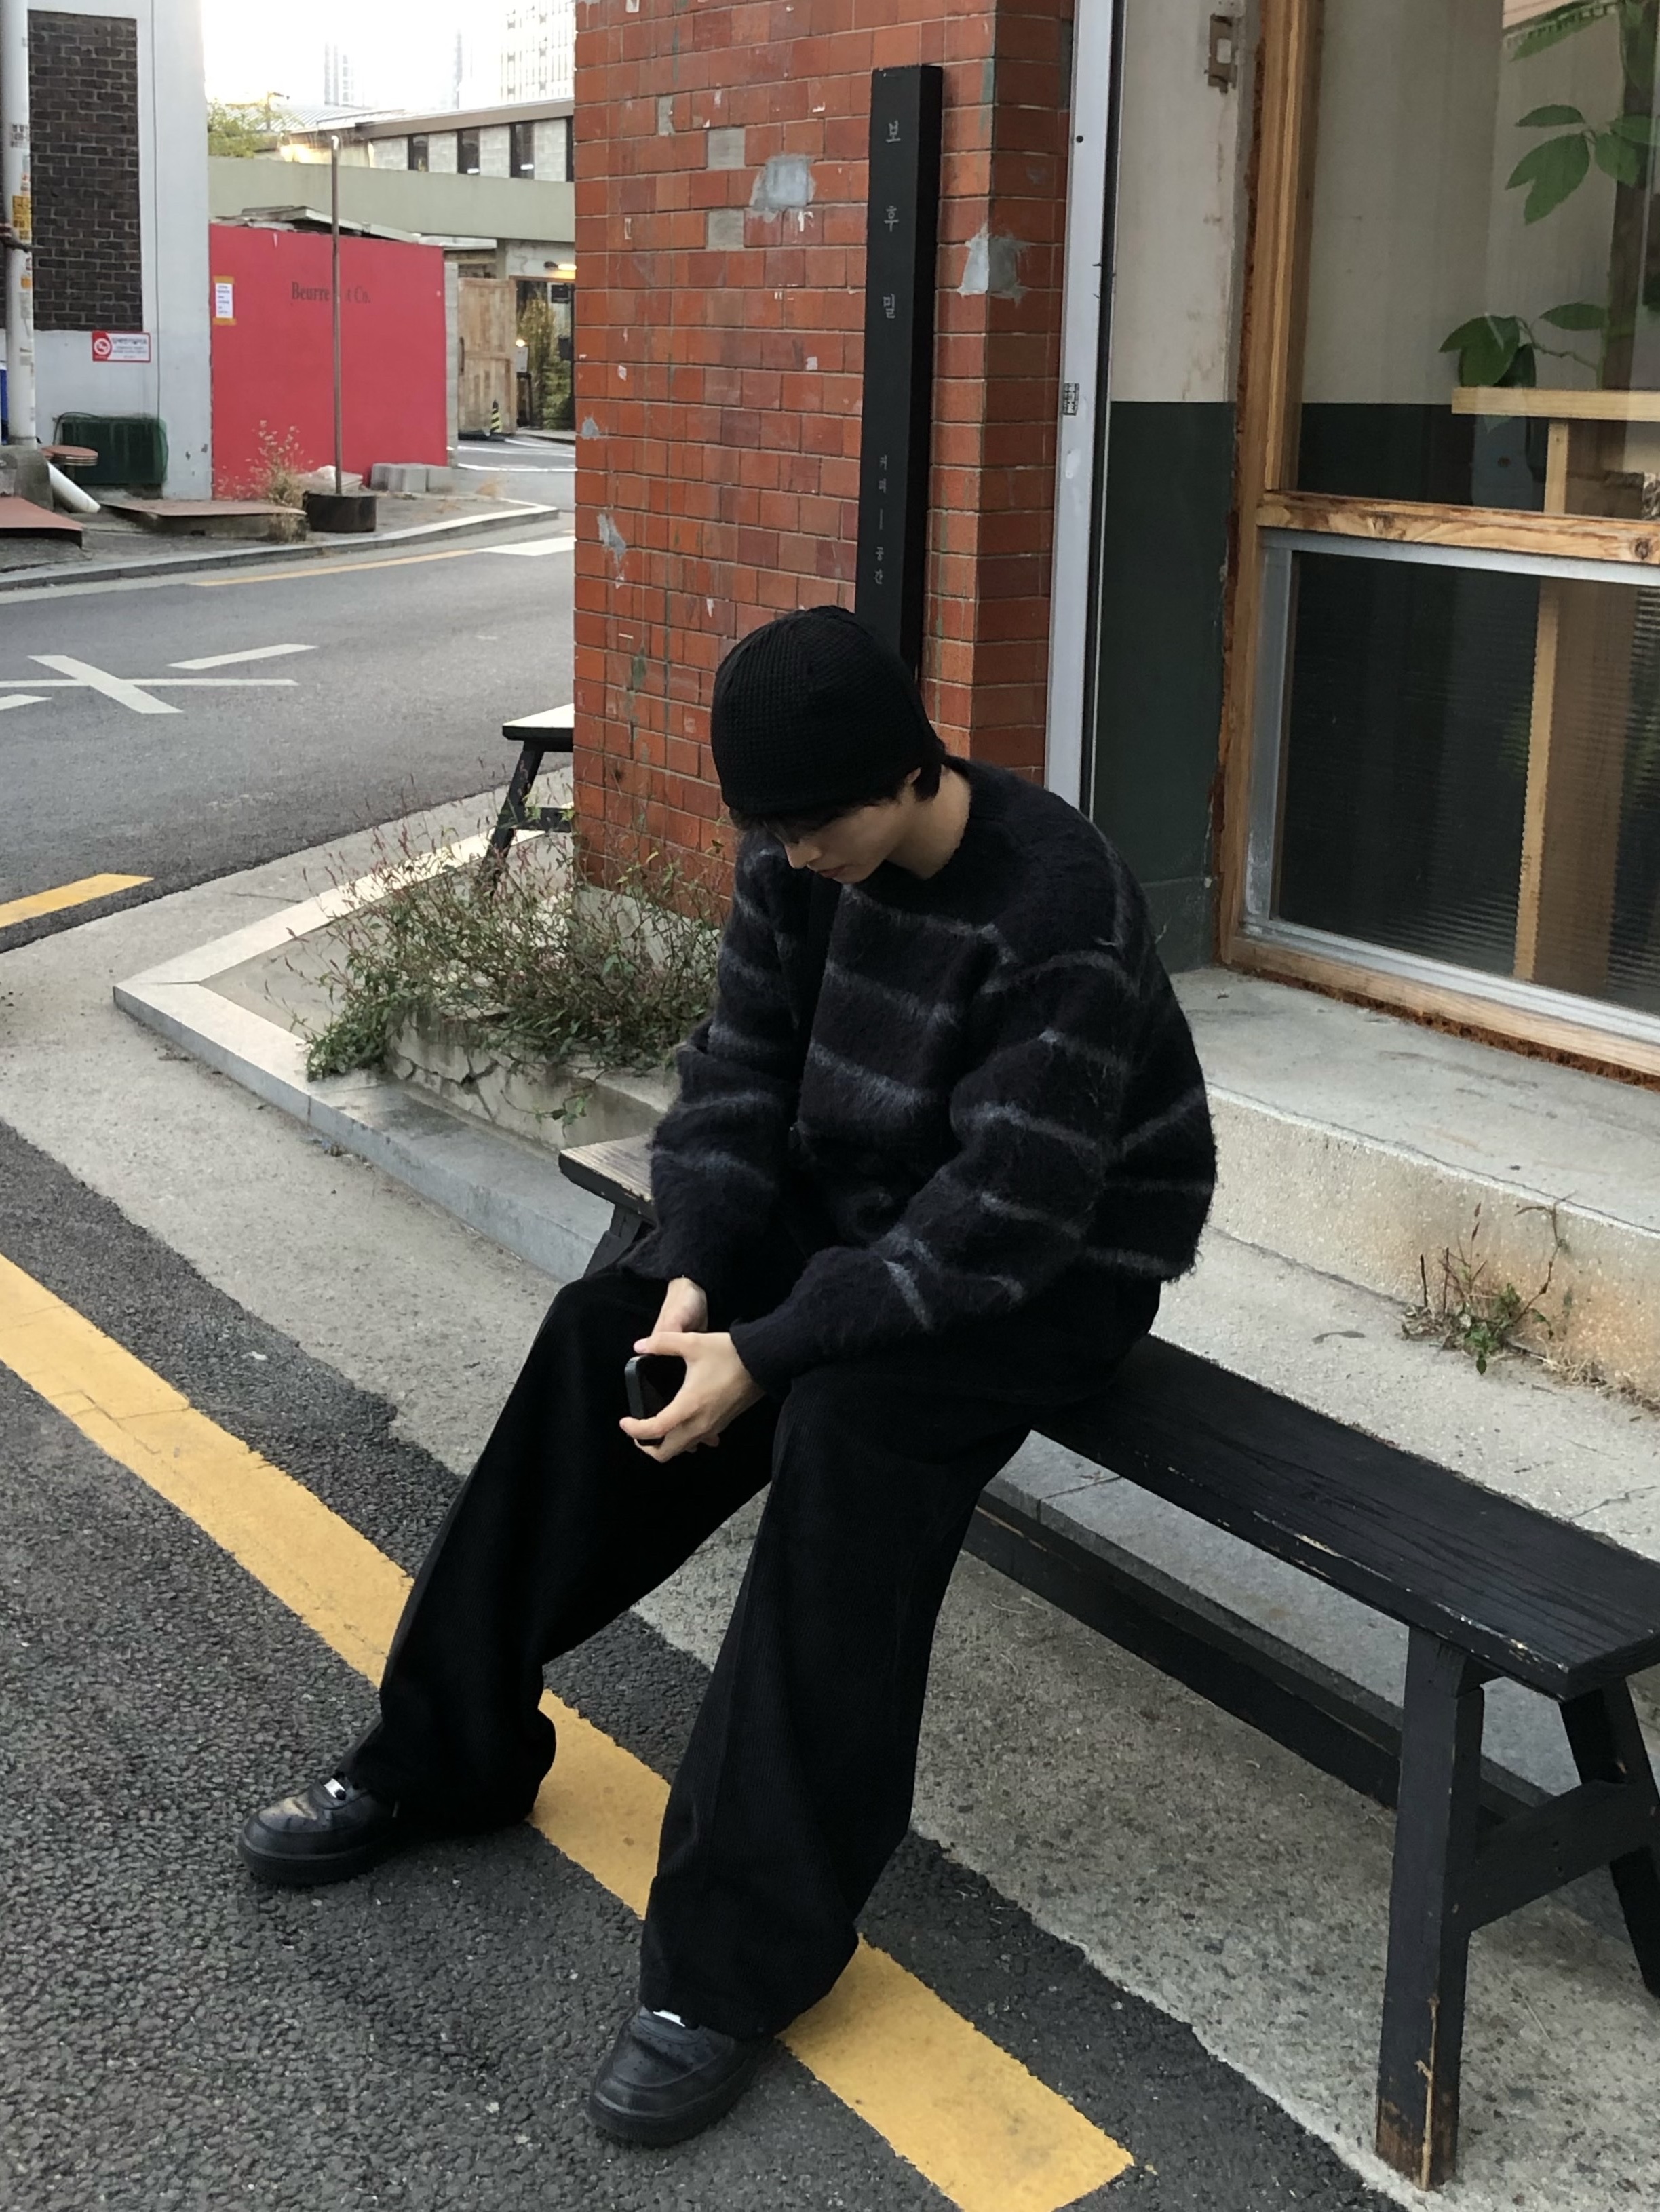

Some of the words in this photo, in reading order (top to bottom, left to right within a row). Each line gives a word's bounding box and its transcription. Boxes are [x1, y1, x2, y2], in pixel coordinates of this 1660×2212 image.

[883, 120, 901, 319] 보후밀
[291, 281, 329, 301] Beurre
[879, 454, 887, 494] 커피
[874, 546, 884, 584] 공간
